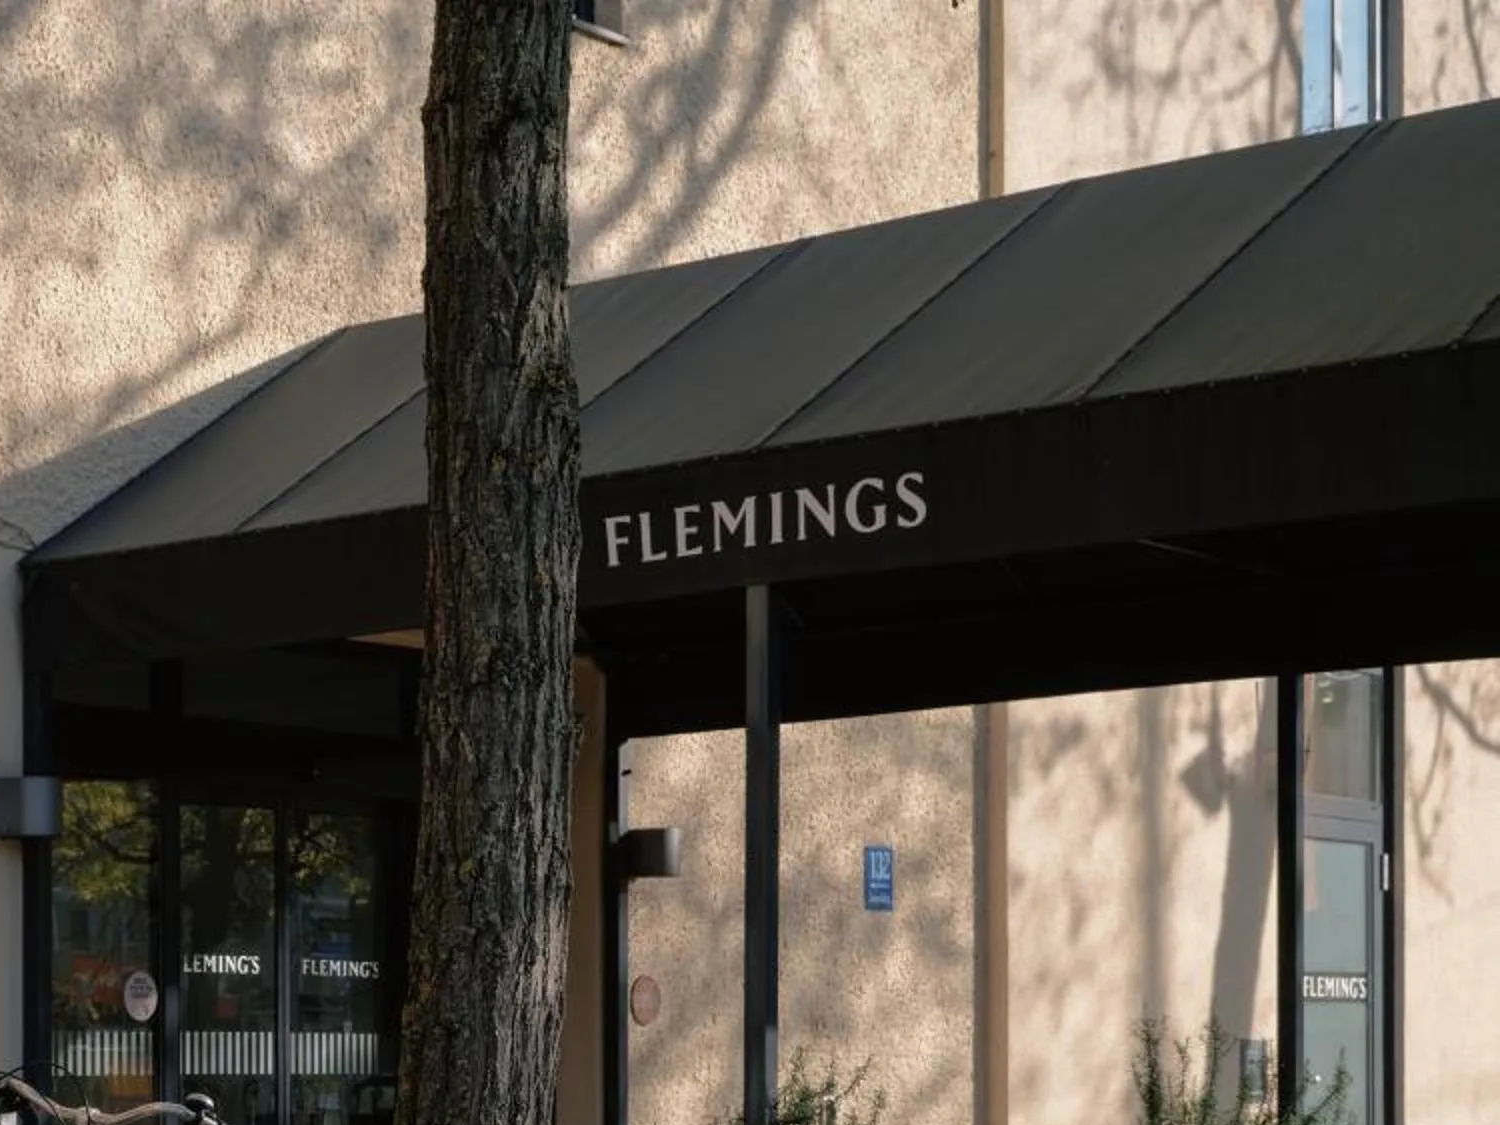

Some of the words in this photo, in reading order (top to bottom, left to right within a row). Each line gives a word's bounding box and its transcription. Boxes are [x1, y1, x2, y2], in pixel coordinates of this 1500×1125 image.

[603, 471, 927, 567] FLEMINGS
[870, 851, 891, 879] 132
[182, 954, 261, 975] LEMING'S
